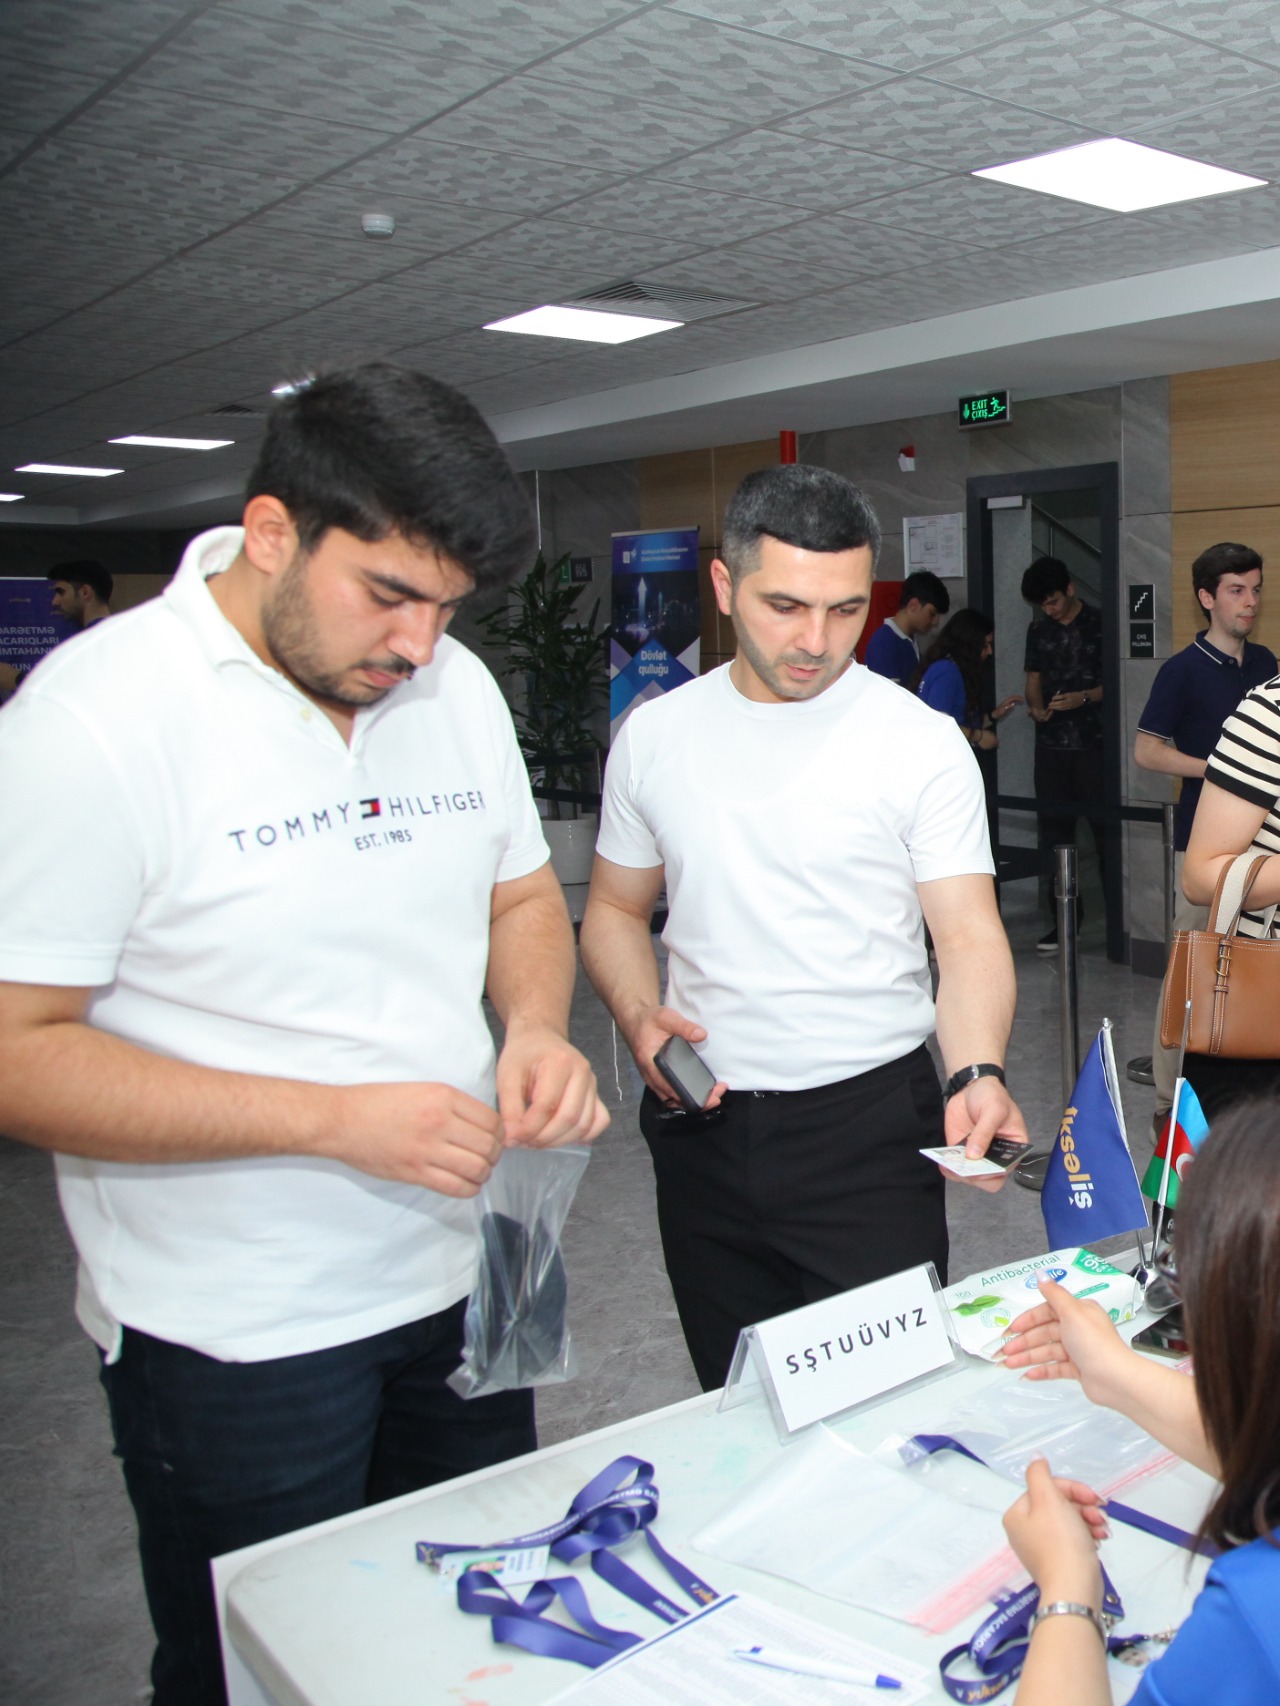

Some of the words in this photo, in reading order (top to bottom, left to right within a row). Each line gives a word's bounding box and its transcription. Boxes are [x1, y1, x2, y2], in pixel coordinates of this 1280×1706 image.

[972, 399, 988, 410] EXIT
[971, 409, 988, 420] ÇIXIŞ
[0, 647, 51, 656] İMTAHAN
[641, 650, 667, 661] Dövlət
[638, 665, 669, 676] qulluğu
[228, 802, 350, 852] TOMMY
[354, 832, 382, 851] EST.
[384, 829, 413, 846] 1985
[1059, 1105, 1095, 1210] ksəliş
[980, 1254, 1061, 1288] Antibacterial
